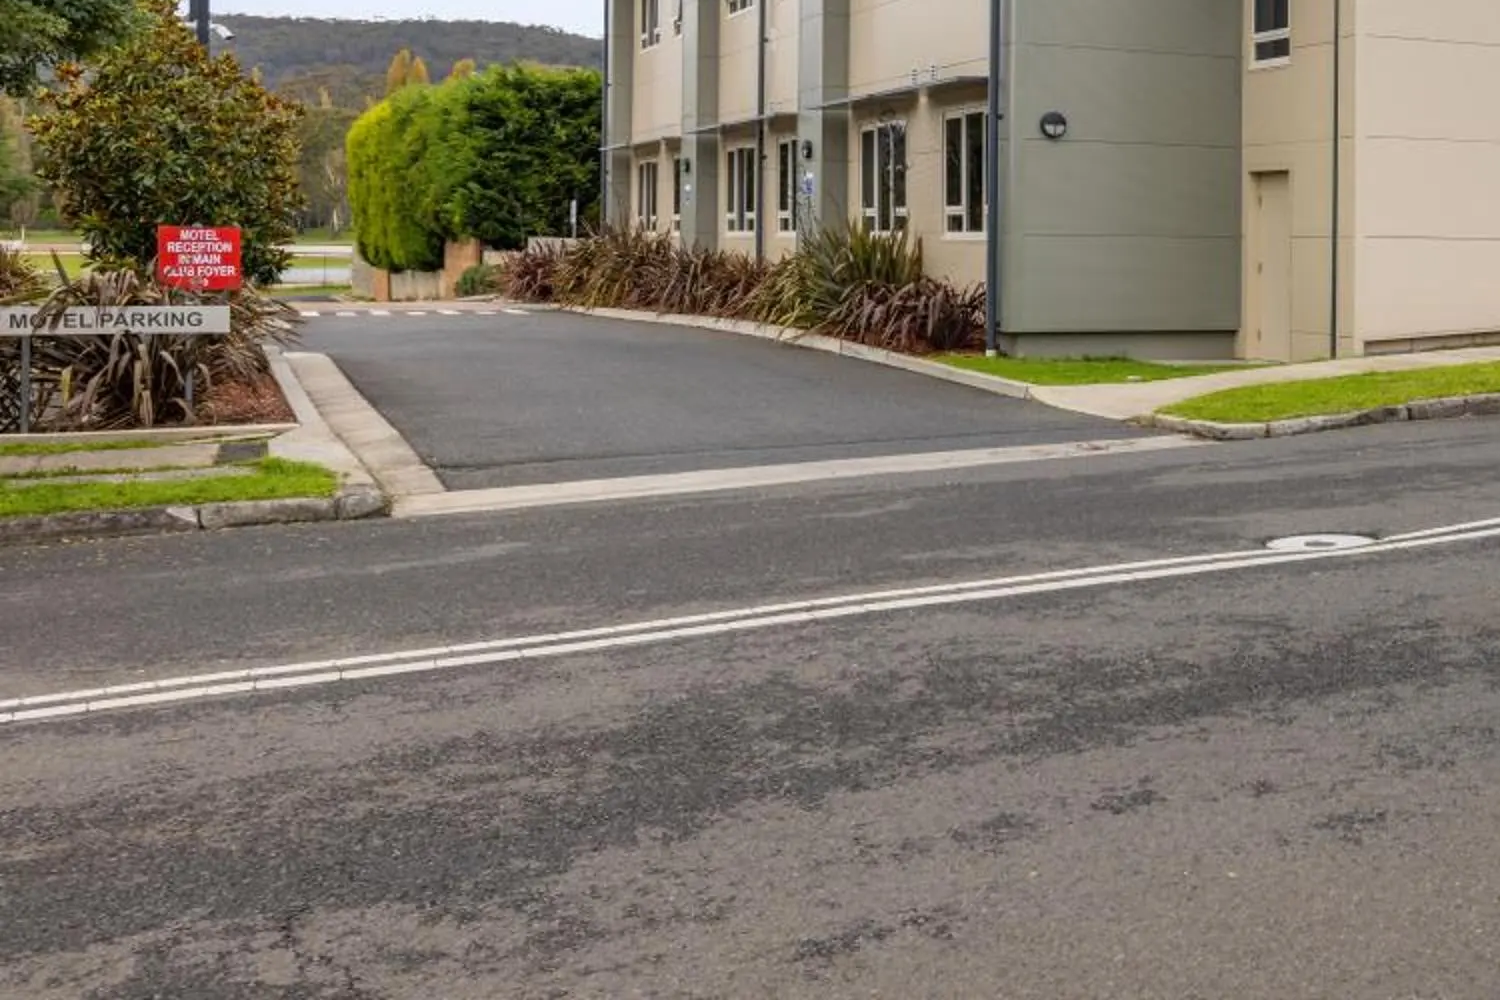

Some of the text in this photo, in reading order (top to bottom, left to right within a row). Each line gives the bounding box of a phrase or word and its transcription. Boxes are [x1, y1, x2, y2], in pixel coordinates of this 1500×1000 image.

[180, 229, 219, 240] MOTEL
[167, 242, 233, 253] RECEPTION
[193, 254, 221, 264] MAIN
[197, 265, 235, 277] FOYER
[100, 311, 204, 328] PARKING
